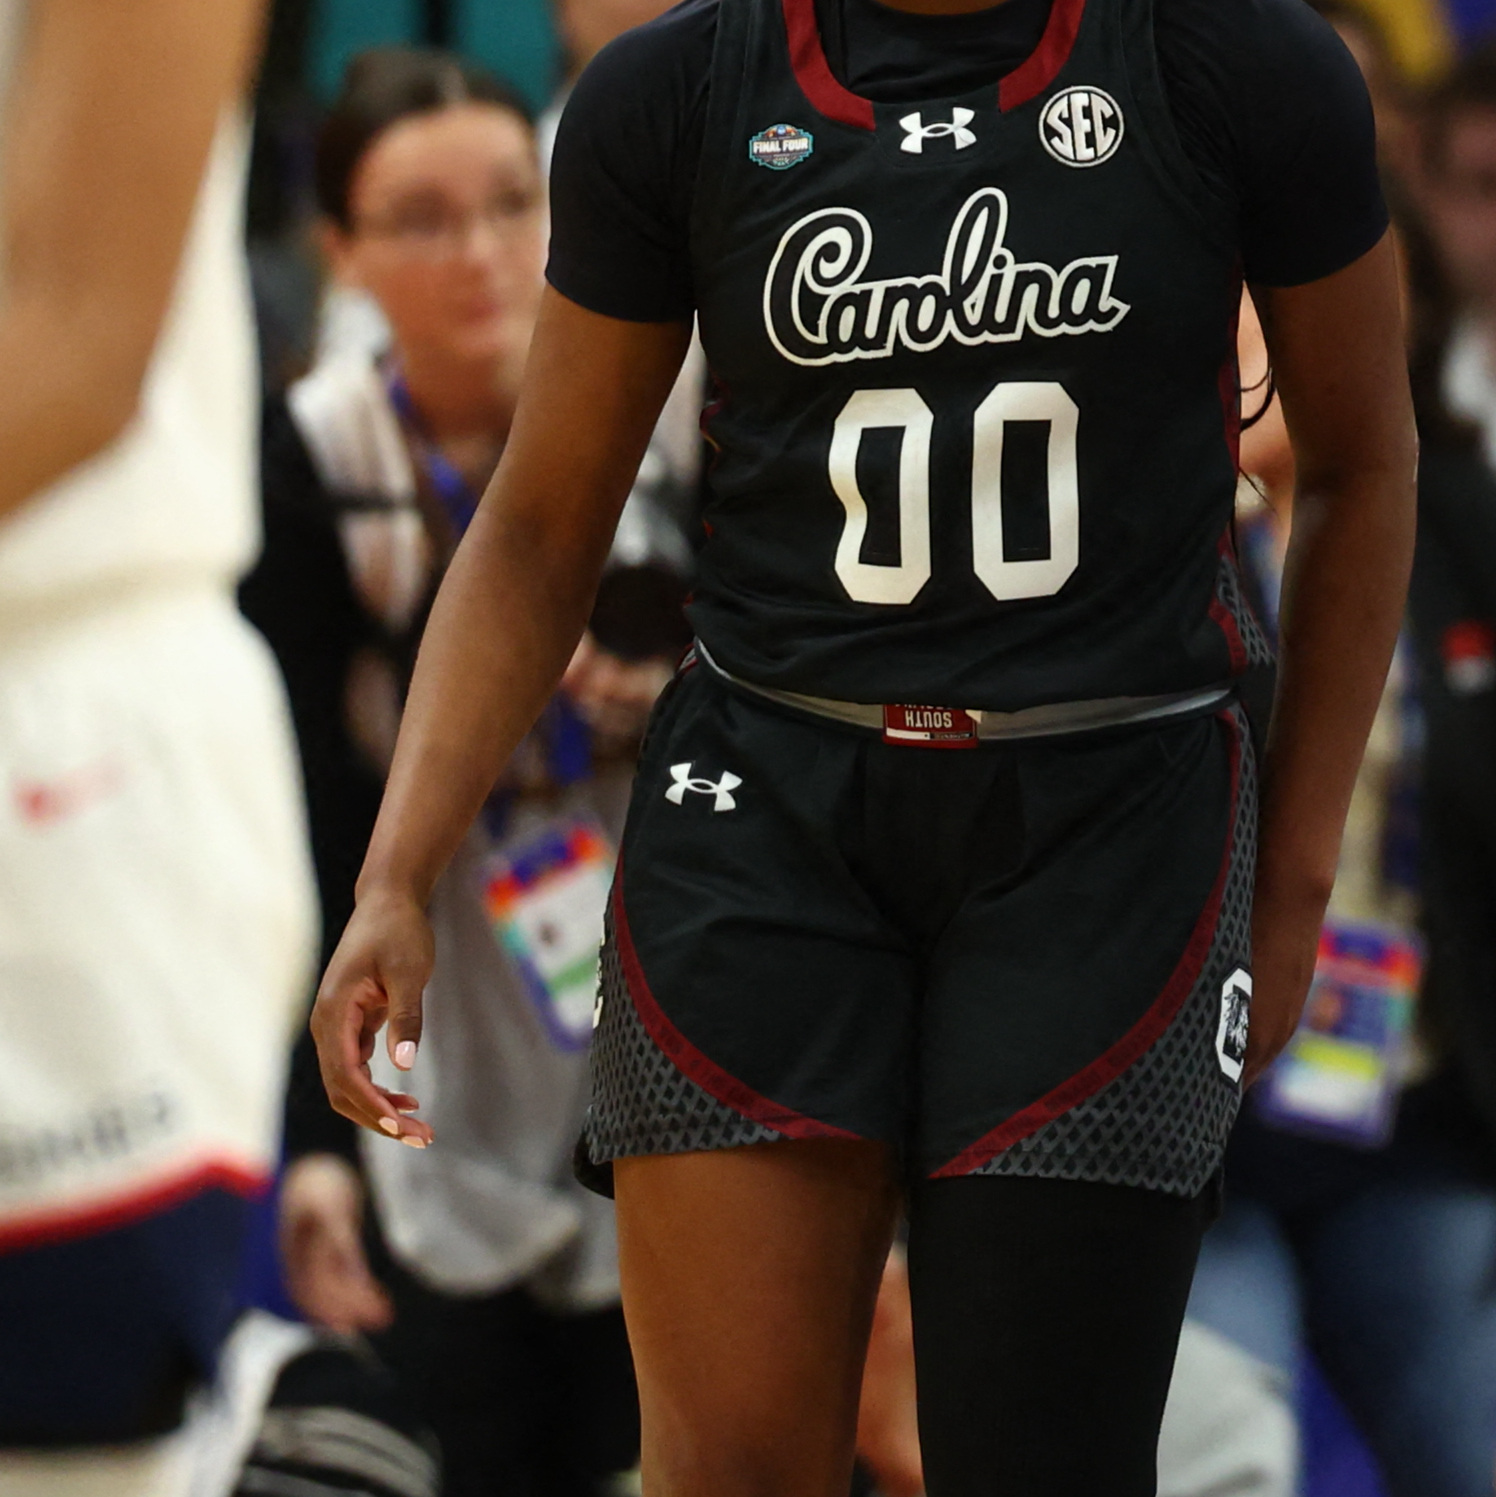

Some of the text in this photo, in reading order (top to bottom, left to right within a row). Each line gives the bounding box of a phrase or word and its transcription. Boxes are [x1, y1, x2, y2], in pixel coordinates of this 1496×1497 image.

[753, 137, 809, 154] FINAL FOUR
[1046, 91, 1117, 161] SEC
[762, 186, 1131, 366] Carolina
[828, 381, 1079, 605] 00
[905, 710, 953, 729] SOUTH
